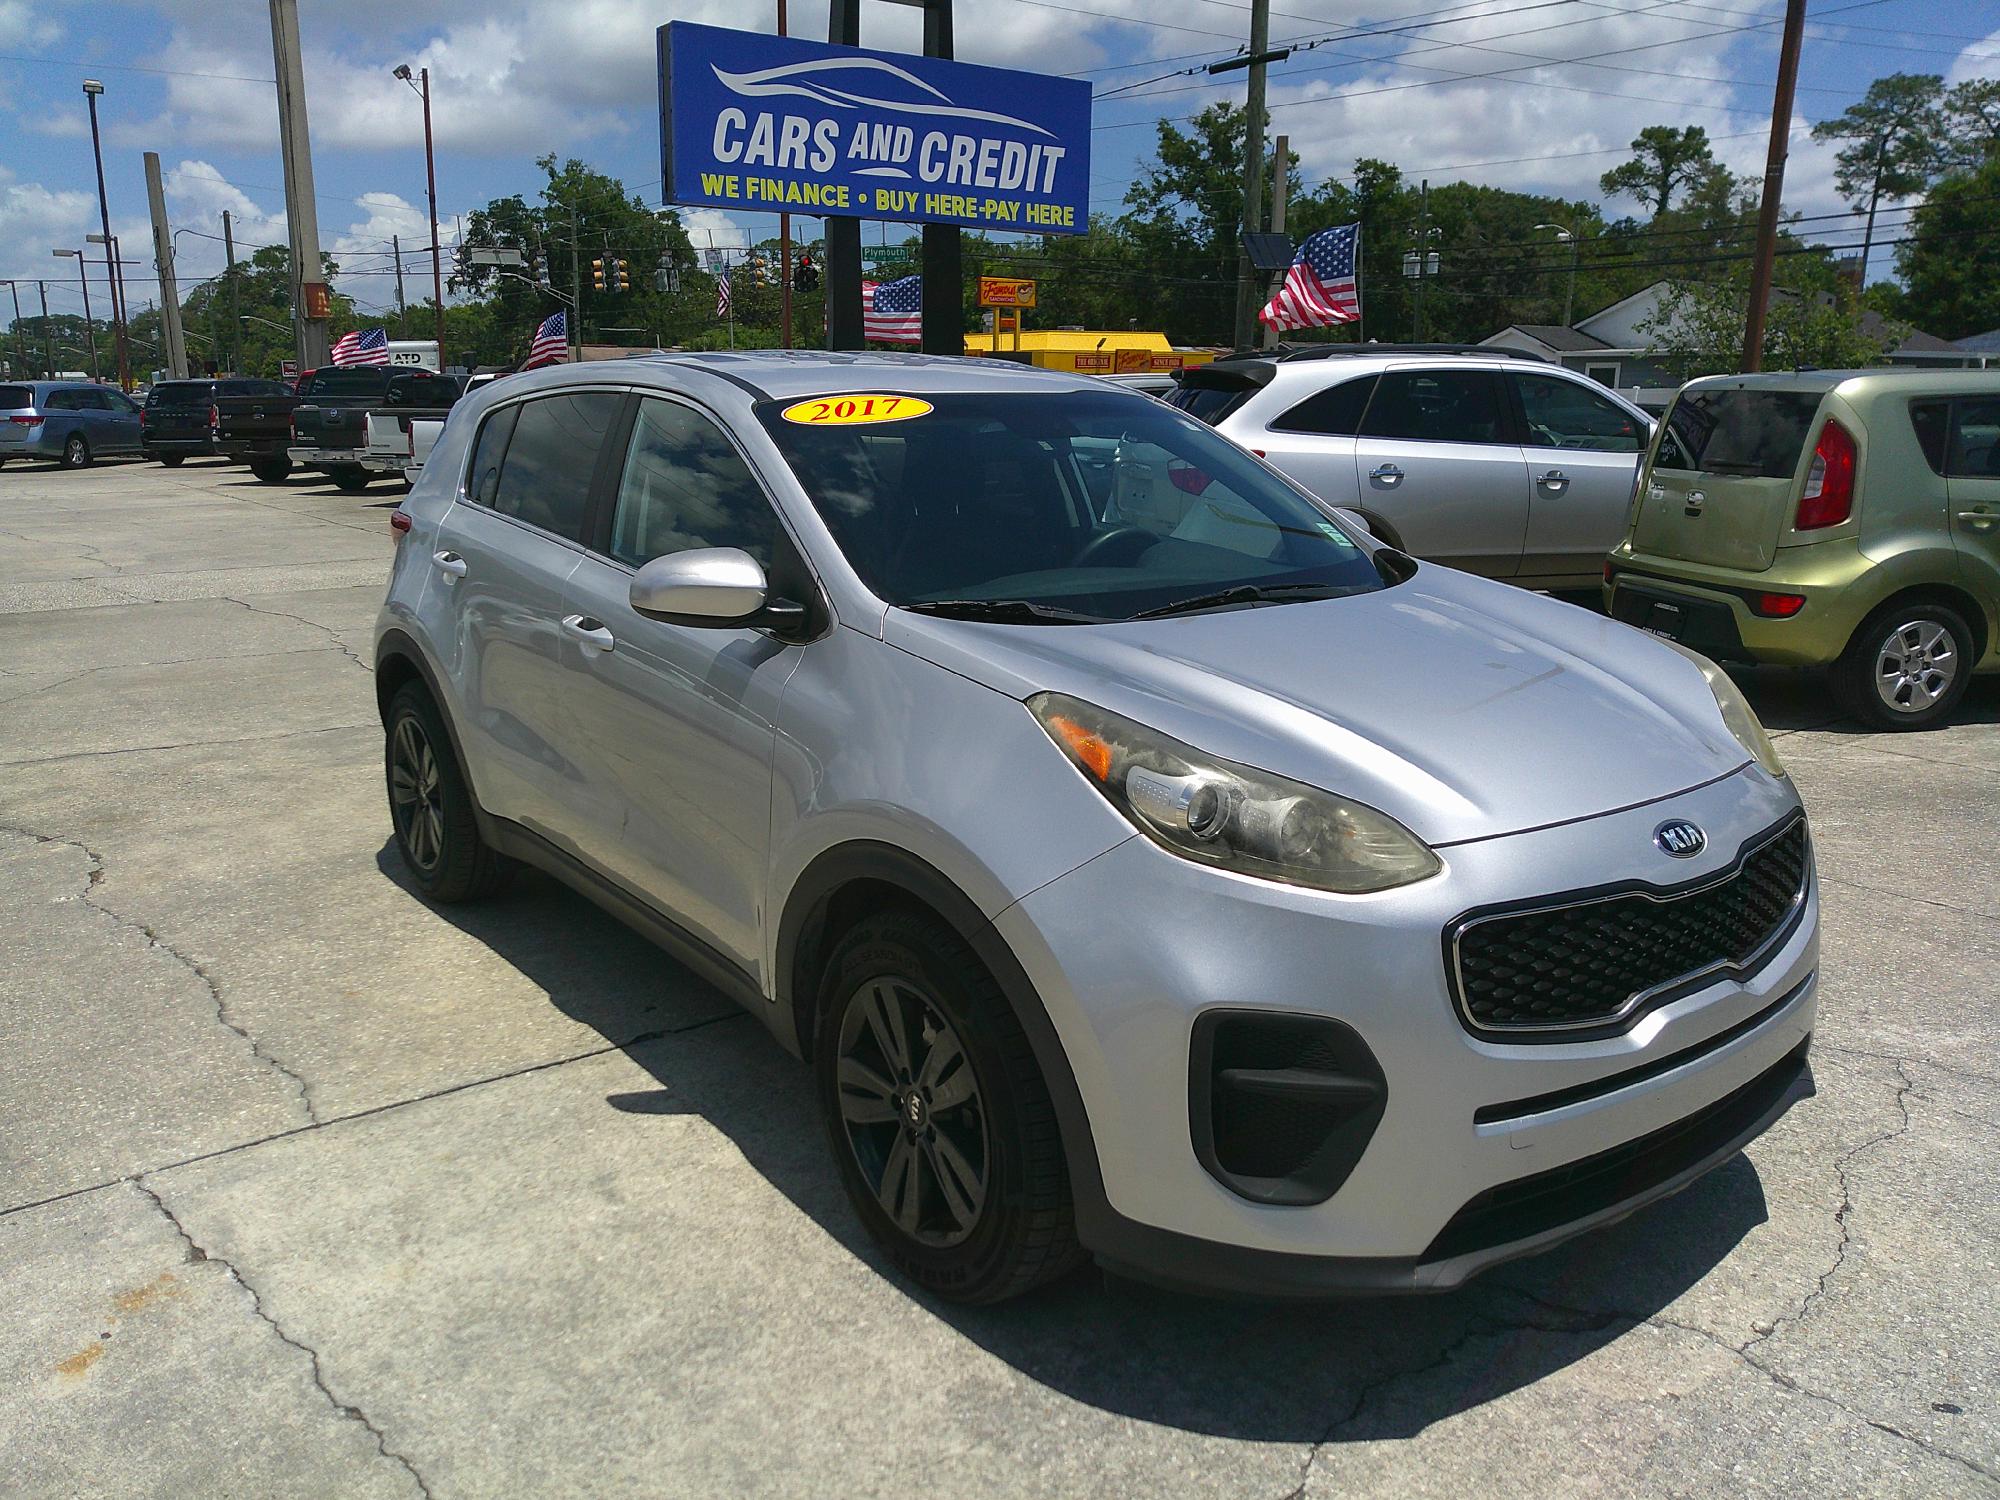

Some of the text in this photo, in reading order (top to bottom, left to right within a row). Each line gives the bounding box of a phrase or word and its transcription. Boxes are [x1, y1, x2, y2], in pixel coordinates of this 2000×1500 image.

[713, 107, 1066, 194] CARS AND CREDIT
[701, 173, 740, 198] WE
[746, 177, 850, 208] FINANCE
[875, 188, 920, 213] BUY
[1026, 202, 1075, 226] HERE
[864, 248, 906, 258] Plymouth
[394, 353, 421, 364] ATD
[811, 399, 902, 421] 2017
[1661, 824, 1703, 851] KIA
